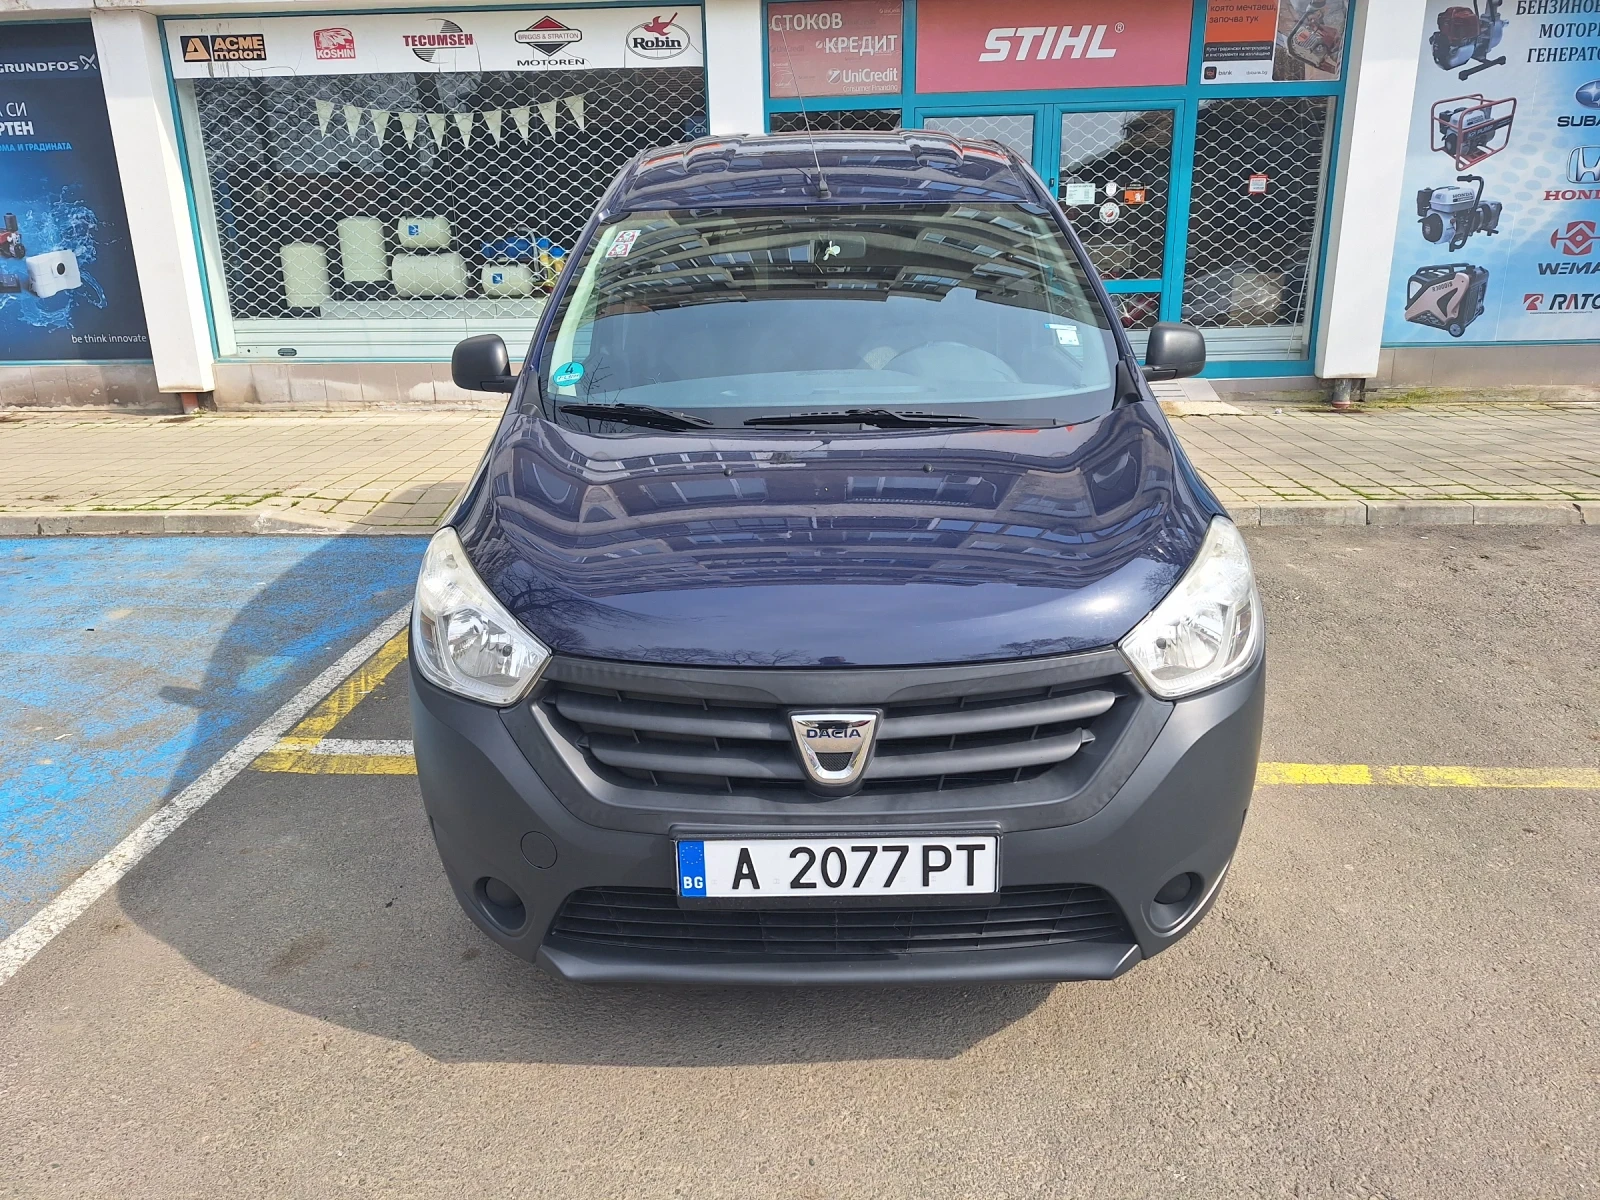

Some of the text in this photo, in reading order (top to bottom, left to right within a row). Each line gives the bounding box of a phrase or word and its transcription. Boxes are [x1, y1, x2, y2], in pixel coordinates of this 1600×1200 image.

[772, 12, 843, 31] СТОКОВ
[1246, 16, 1259, 24] тук
[214, 36, 264, 50] ACME
[402, 34, 474, 46] TECUMSEH
[632, 36, 682, 50] Robin
[826, 35, 898, 56] КРЕДИТ
[978, 24, 1117, 62] STIHL
[214, 50, 266, 60] motori
[316, 49, 354, 58] KOSHIN
[842, 68, 898, 82] UniCredit
[6, 102, 28, 116] СИ
[25, 142, 72, 152] ГРАДИНАТА
[72, 334, 146, 343] be think innovate
[806, 728, 862, 738] DACIA
[732, 844, 986, 890] A 2077 PT
[683, 876, 704, 889] BG
